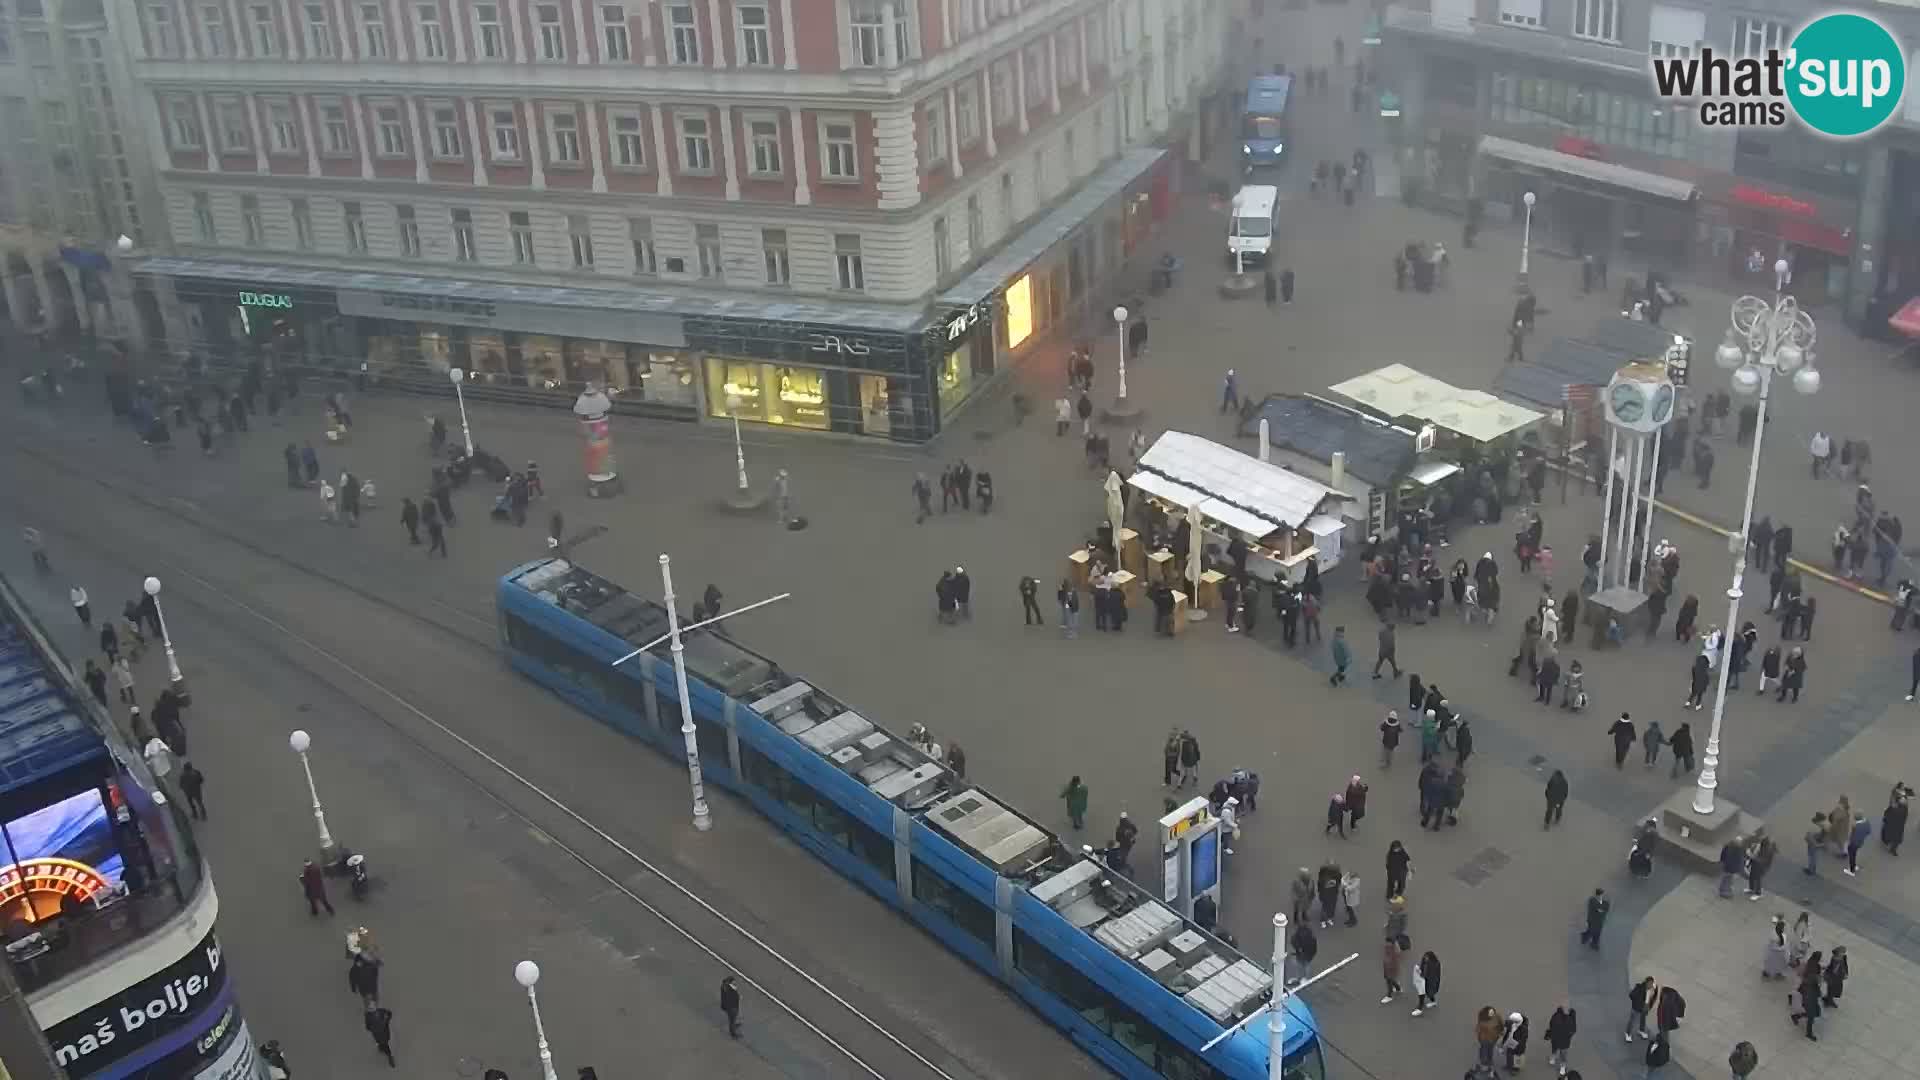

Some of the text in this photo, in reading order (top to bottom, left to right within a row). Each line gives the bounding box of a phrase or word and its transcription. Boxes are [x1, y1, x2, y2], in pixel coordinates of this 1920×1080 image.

[239, 292, 293, 308] DOUGLAS
[55, 1017, 116, 1067] naš
[120, 973, 209, 1032] bolje,
